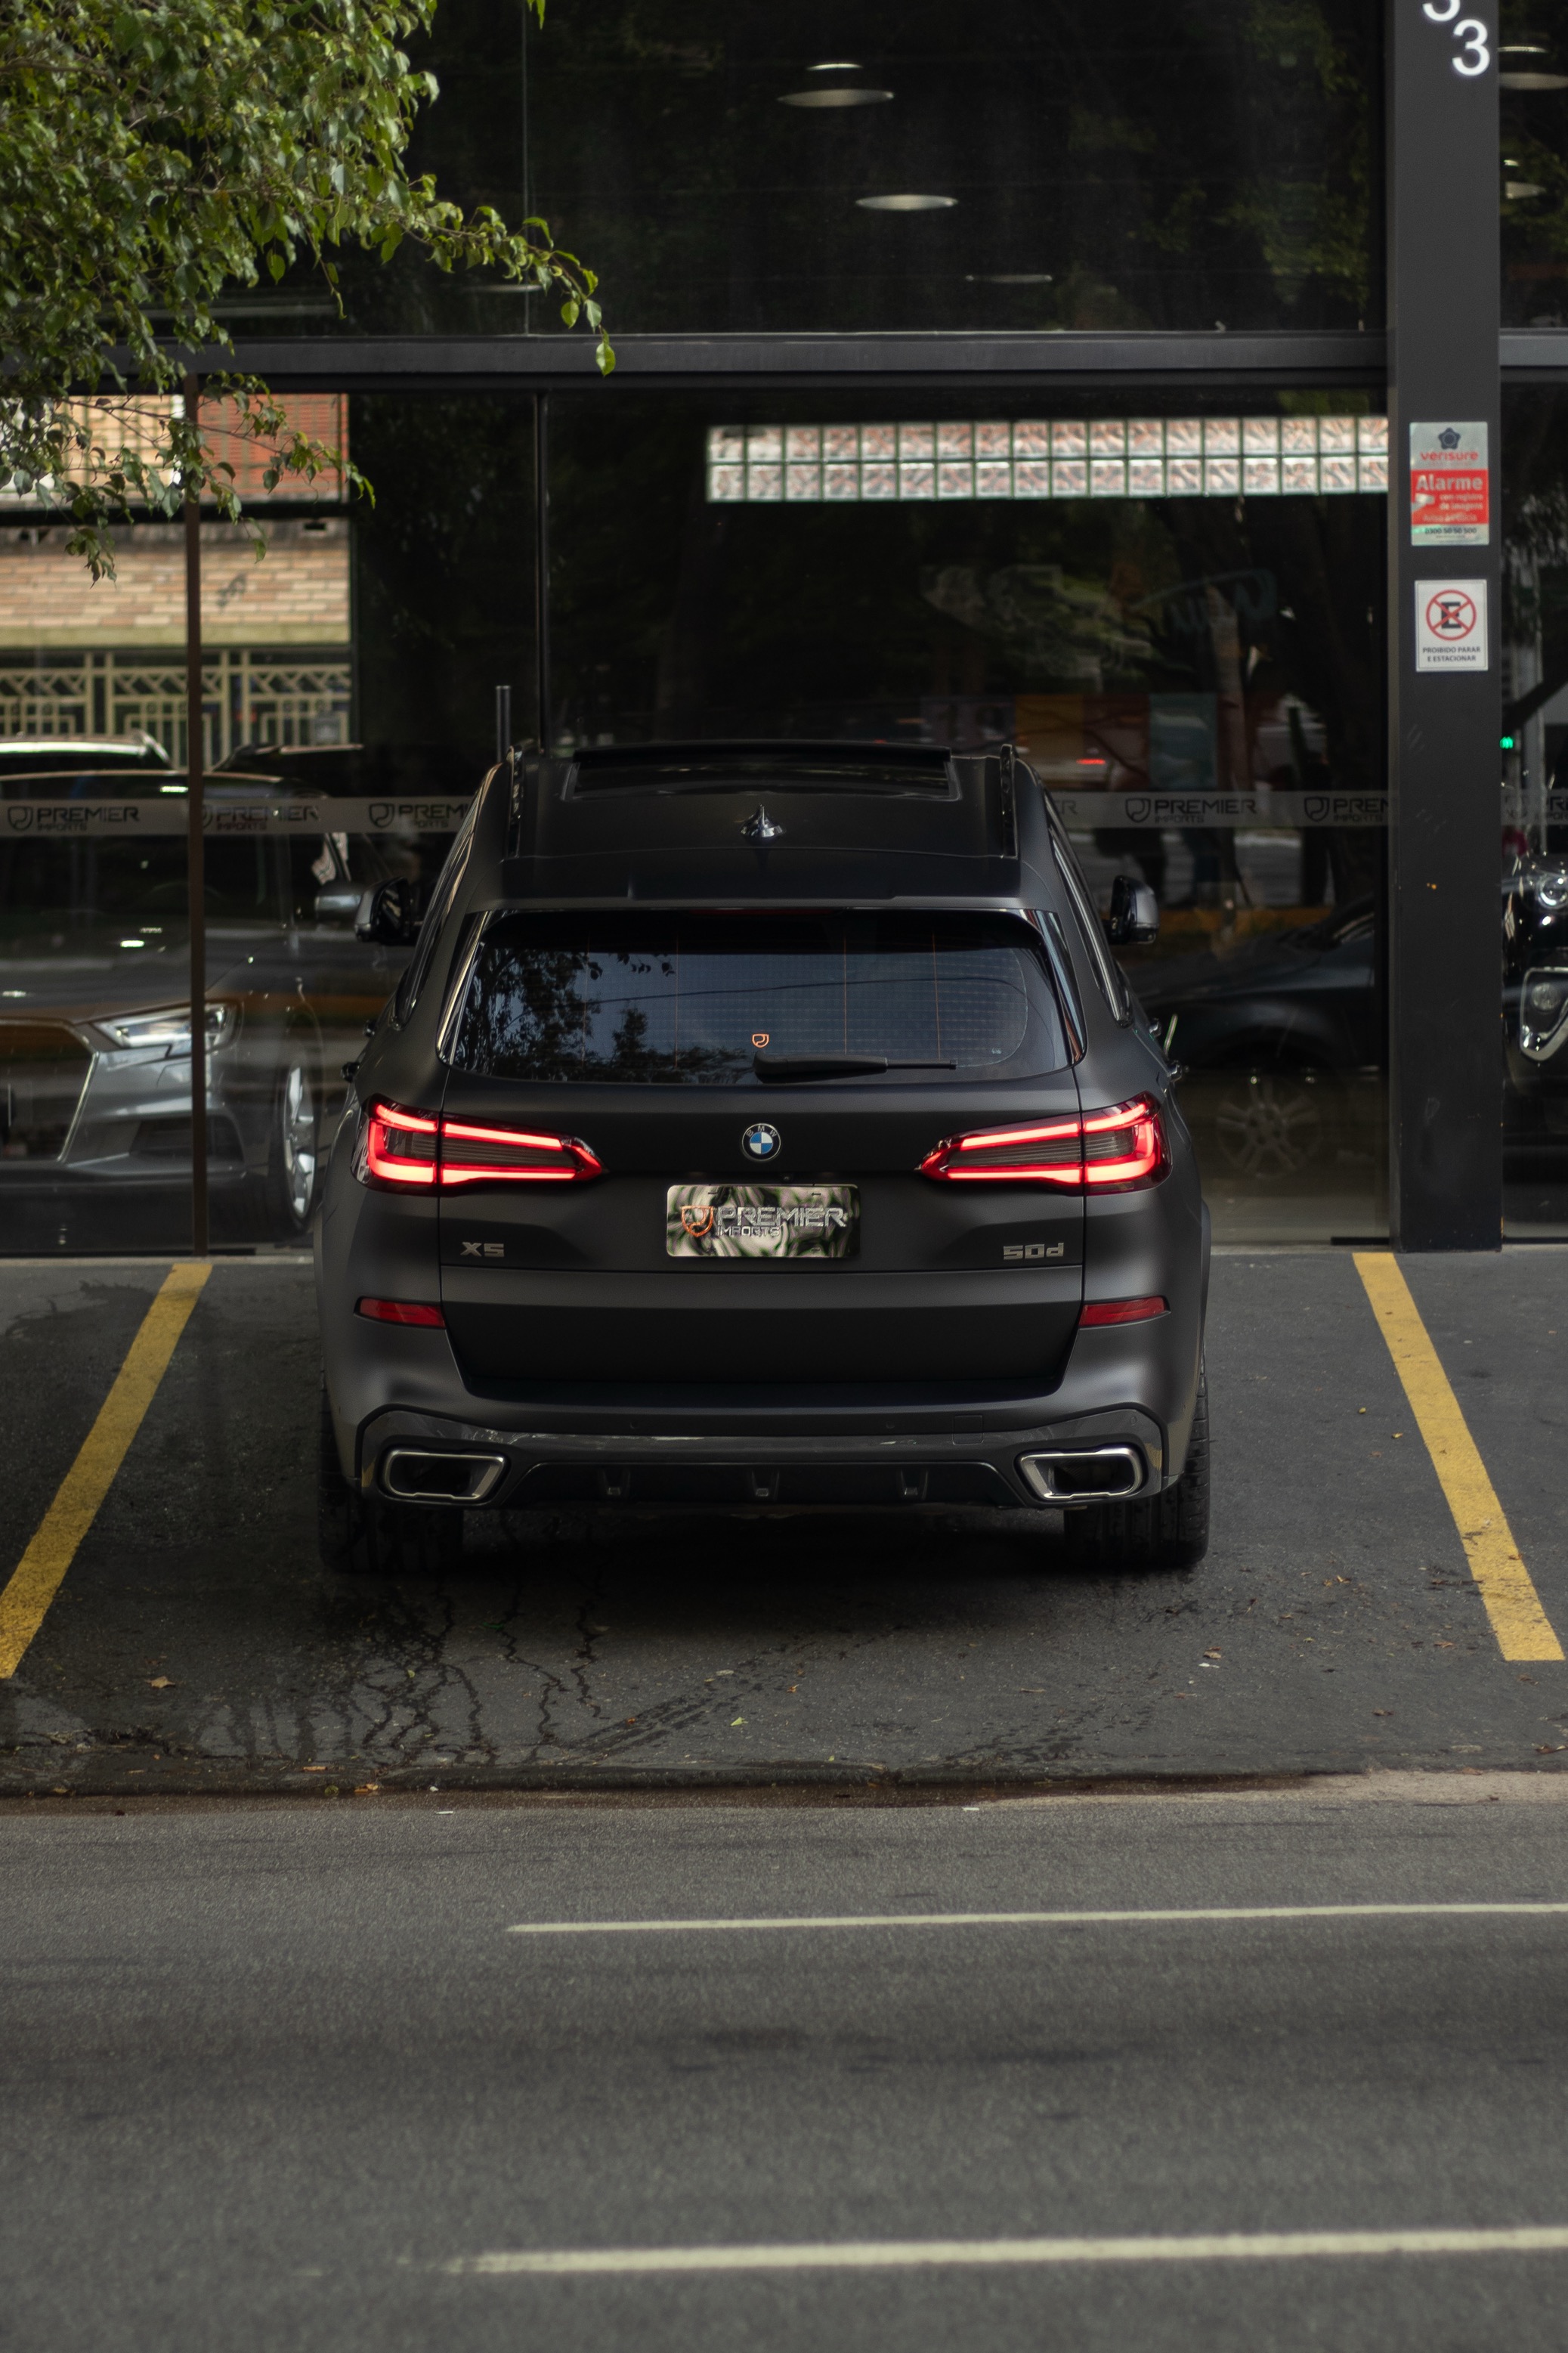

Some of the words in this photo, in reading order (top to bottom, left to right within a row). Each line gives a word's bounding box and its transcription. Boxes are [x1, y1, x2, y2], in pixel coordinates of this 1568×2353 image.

[1420, 450, 1479, 461] verisure
[1415, 474, 1483, 491] Alarme
[38, 806, 140, 822] PREMIER
[1155, 798, 1257, 815] PREMIER
[1155, 816, 1204, 824] IMPORTS
[718, 1206, 847, 1228] PREMIER
[718, 1226, 781, 1237] IMPORTS
[460, 1241, 505, 1258] X5
[1003, 1242, 1064, 1260] 50d
